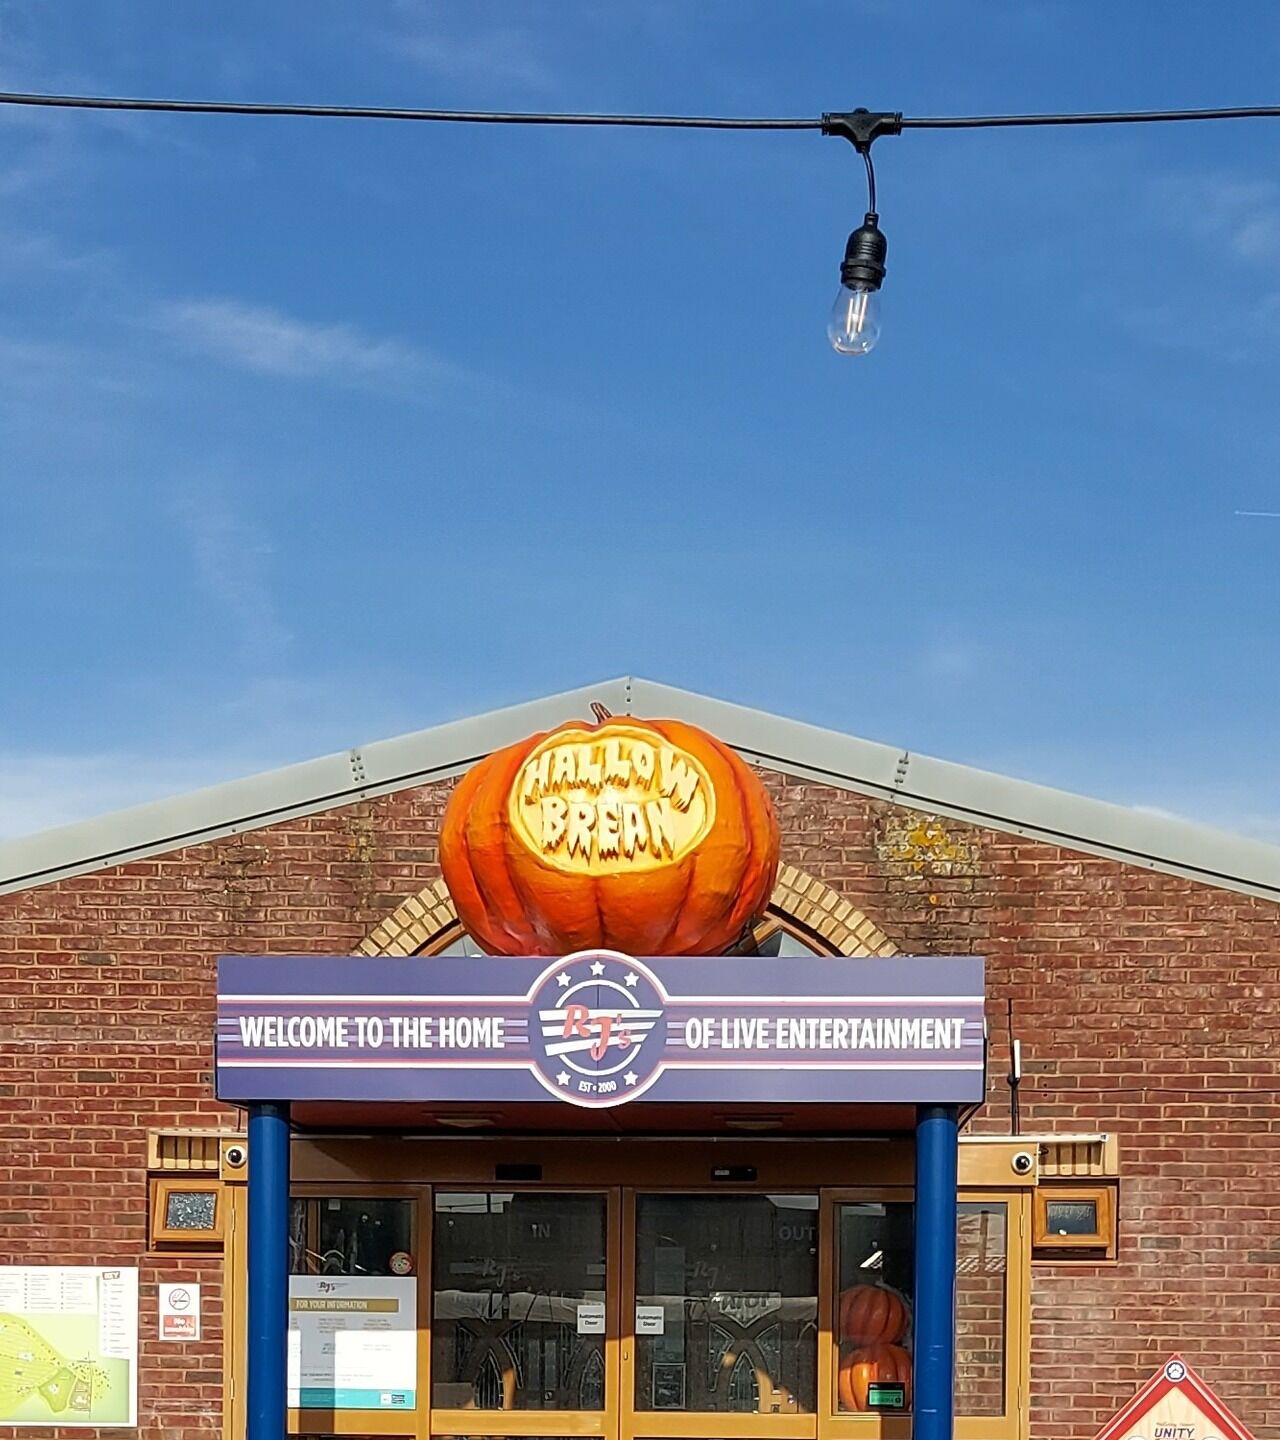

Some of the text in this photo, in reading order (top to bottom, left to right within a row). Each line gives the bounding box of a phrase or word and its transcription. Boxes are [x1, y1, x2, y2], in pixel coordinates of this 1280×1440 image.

[524, 740, 699, 813] HALLOW
[540, 796, 673, 862] BREAN
[239, 1016, 505, 1048] WELCOME TO THE HOME
[562, 1005, 631, 1061] RJ's
[685, 1018, 964, 1049] OF LIVE ENTERTAINMENT
[578, 1081, 617, 1093] EST 2000
[779, 1227, 815, 1240] OUT
[295, 1300, 368, 1310] FOR YOUR INFORMATION
[1154, 1428, 1195, 1438] UNITY
